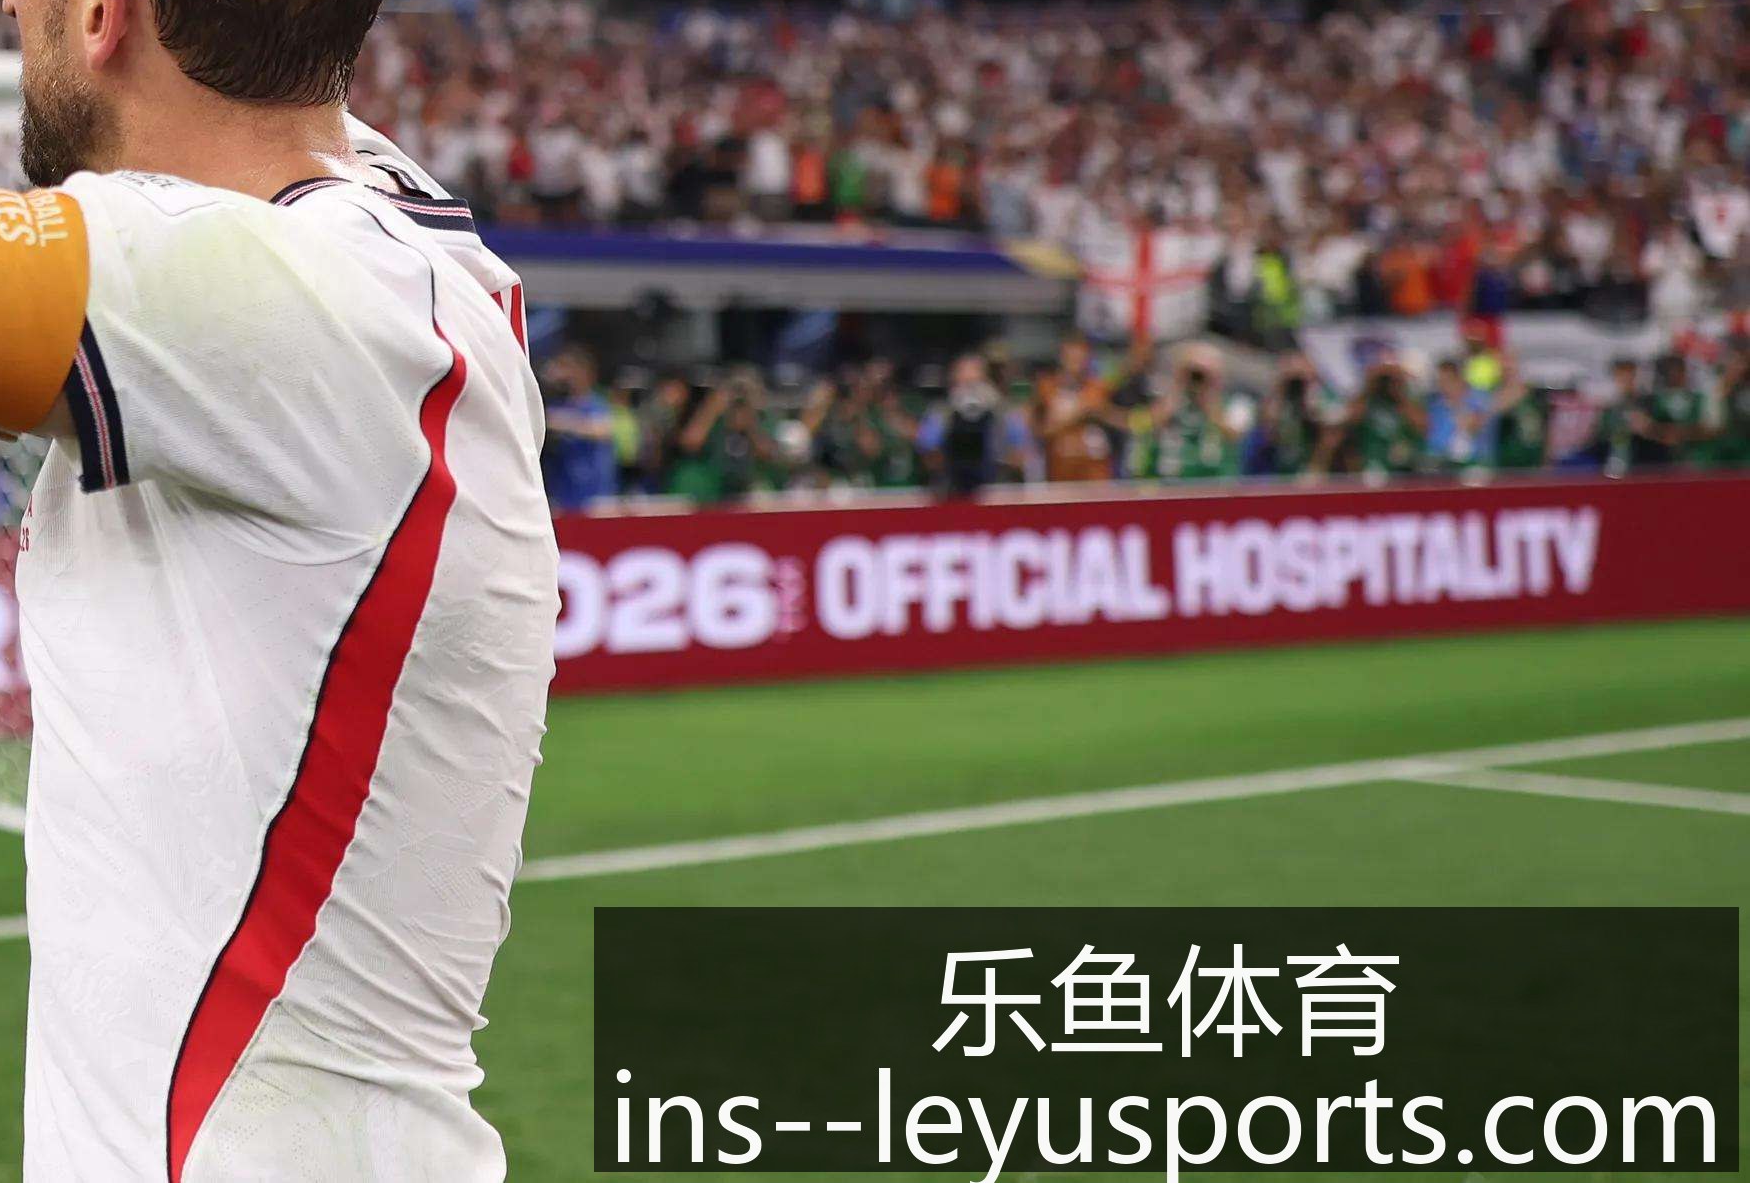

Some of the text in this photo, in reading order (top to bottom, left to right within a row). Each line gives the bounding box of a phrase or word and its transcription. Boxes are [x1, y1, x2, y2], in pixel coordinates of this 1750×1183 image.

[555, 541, 777, 660] 026
[814, 524, 1172, 641] OFFICIAL
[1172, 504, 1602, 616] HOSPITALITY
